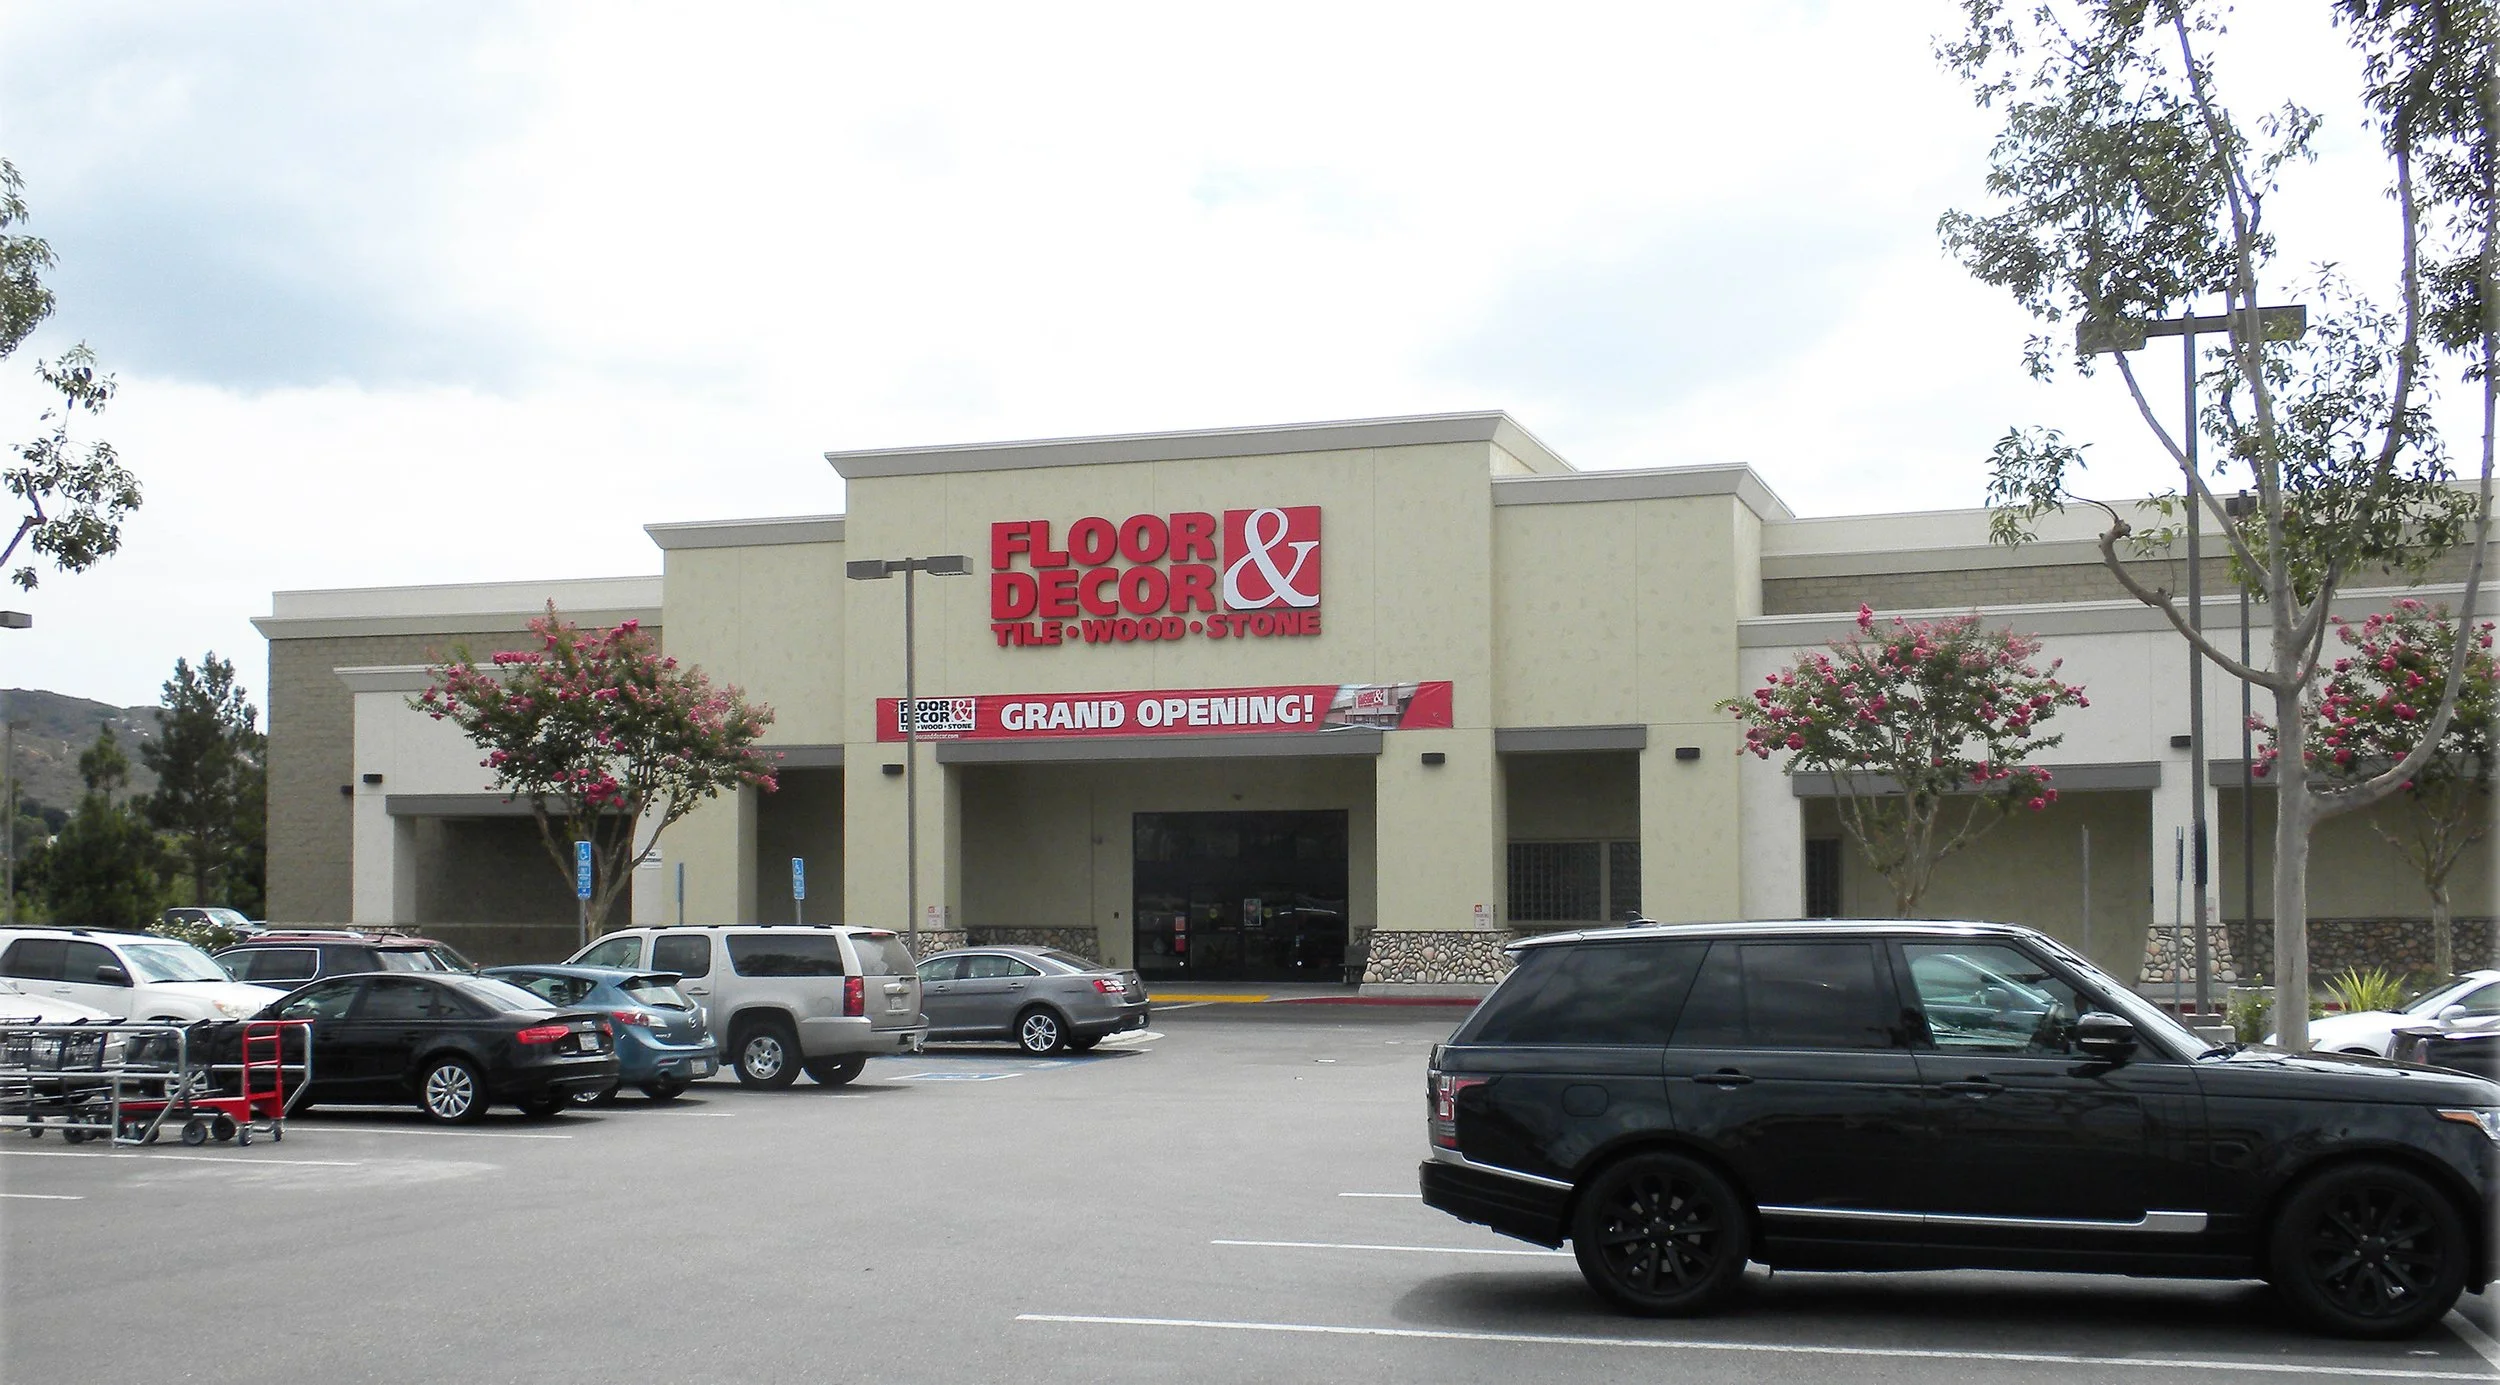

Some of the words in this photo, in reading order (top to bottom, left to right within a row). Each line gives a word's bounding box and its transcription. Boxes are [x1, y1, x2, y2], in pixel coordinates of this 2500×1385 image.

[991, 512, 1217, 569] FLOOR
[1223, 507, 1320, 611] &
[991, 563, 1217, 620] DECOR
[990, 620, 1063, 647] TILE
[1080, 616, 1186, 643] WOOD
[1206, 610, 1321, 639] STONE
[900, 700, 950, 712] FOOR
[1000, 700, 1126, 731] GRAND
[1136, 694, 1315, 727] OPENING!
